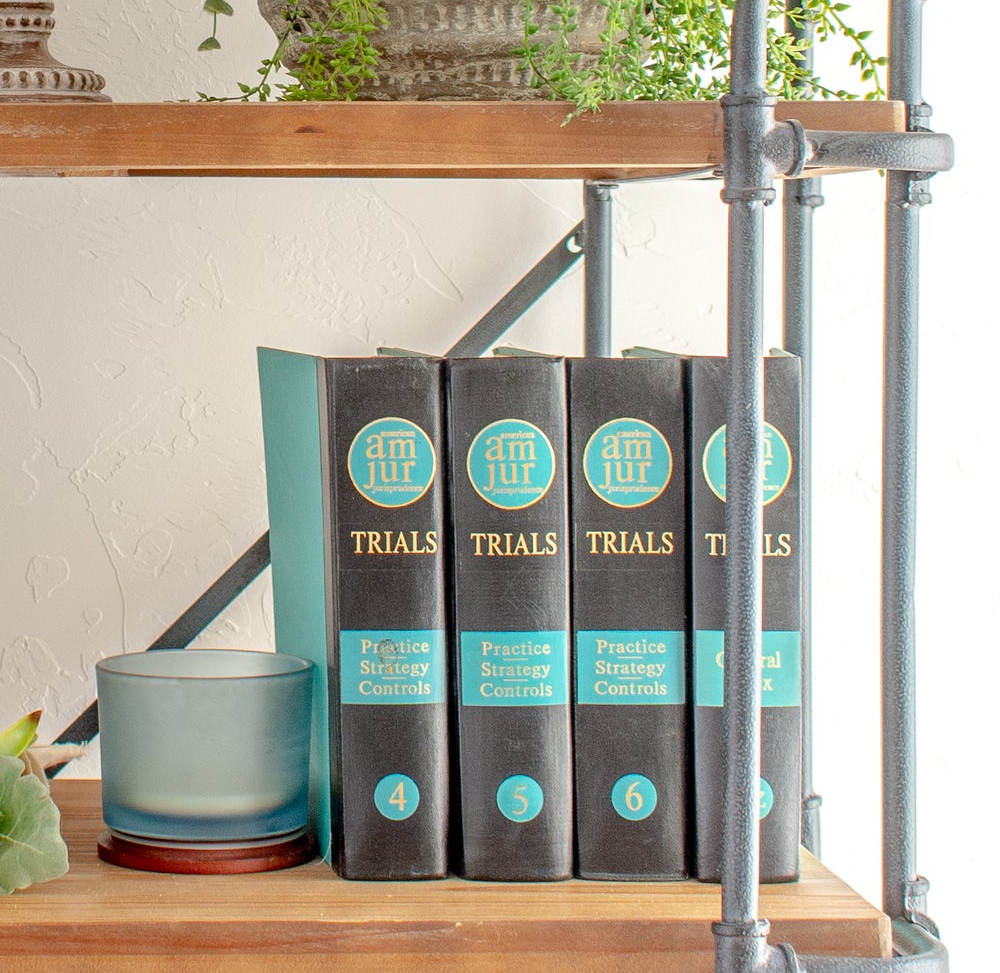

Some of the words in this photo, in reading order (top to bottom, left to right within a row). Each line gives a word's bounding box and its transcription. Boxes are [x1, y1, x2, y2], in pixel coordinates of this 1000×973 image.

[365, 433, 417, 460] am
[484, 435, 537, 461] am
[601, 434, 653, 460] am
[363, 460, 416, 489] jur
[483, 462, 536, 491] jur
[599, 460, 652, 489] jur
[350, 531, 438, 555] TRIALS
[470, 532, 558, 557] TRIALS
[586, 531, 674, 555] TRIALS
[705, 533, 792, 557] TLS
[360, 639, 430, 654] Practice
[481, 641, 551, 655] Practice
[596, 639, 666, 654] Practice
[360, 660, 430, 677] Strategy
[481, 662, 551, 679] Strategy
[595, 660, 665, 677] Strategy
[358, 681, 431, 696] Controls
[479, 683, 553, 698] Controls
[594, 681, 668, 696] Controls
[388, 782, 407, 812] 4
[511, 785, 529, 815] 5
[625, 781, 643, 811] 6
